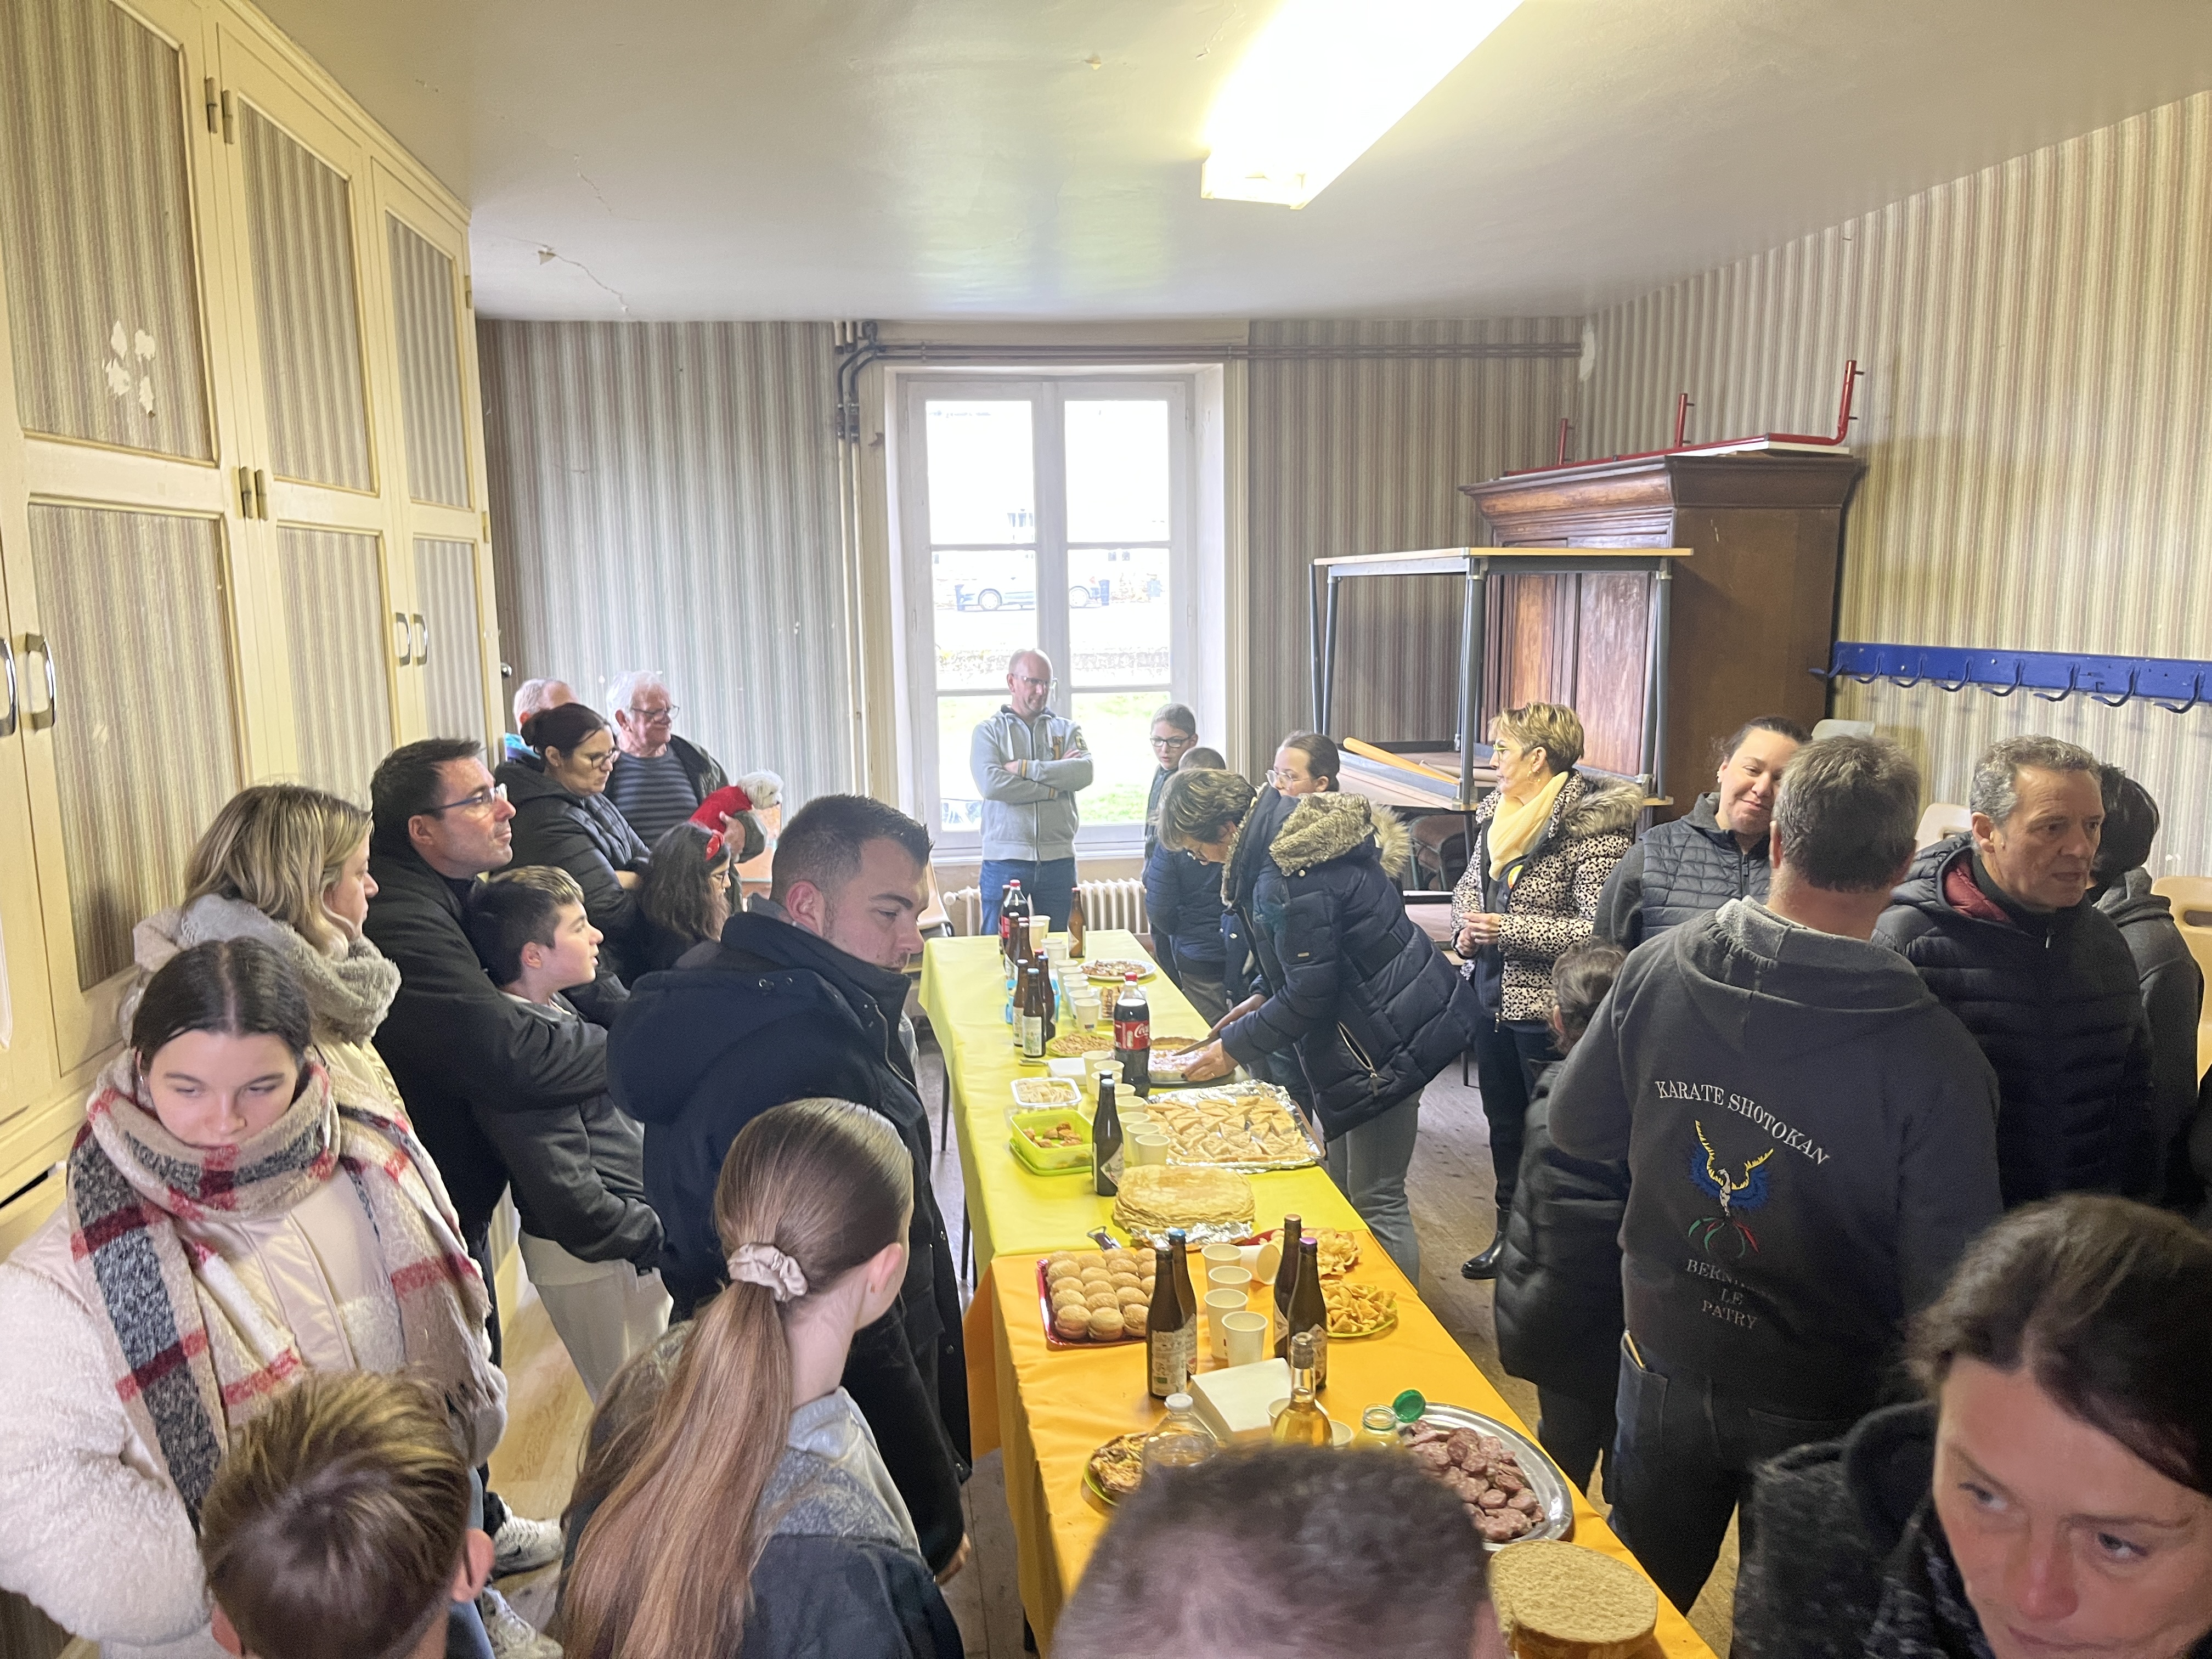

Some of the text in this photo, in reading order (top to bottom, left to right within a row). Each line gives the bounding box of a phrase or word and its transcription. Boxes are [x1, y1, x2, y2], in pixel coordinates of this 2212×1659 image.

[1655, 1080, 1830, 1165] KARATE SHOTOKAN
[1721, 1288, 1743, 1305] LE
[1702, 1299, 1758, 1329] PATRY
